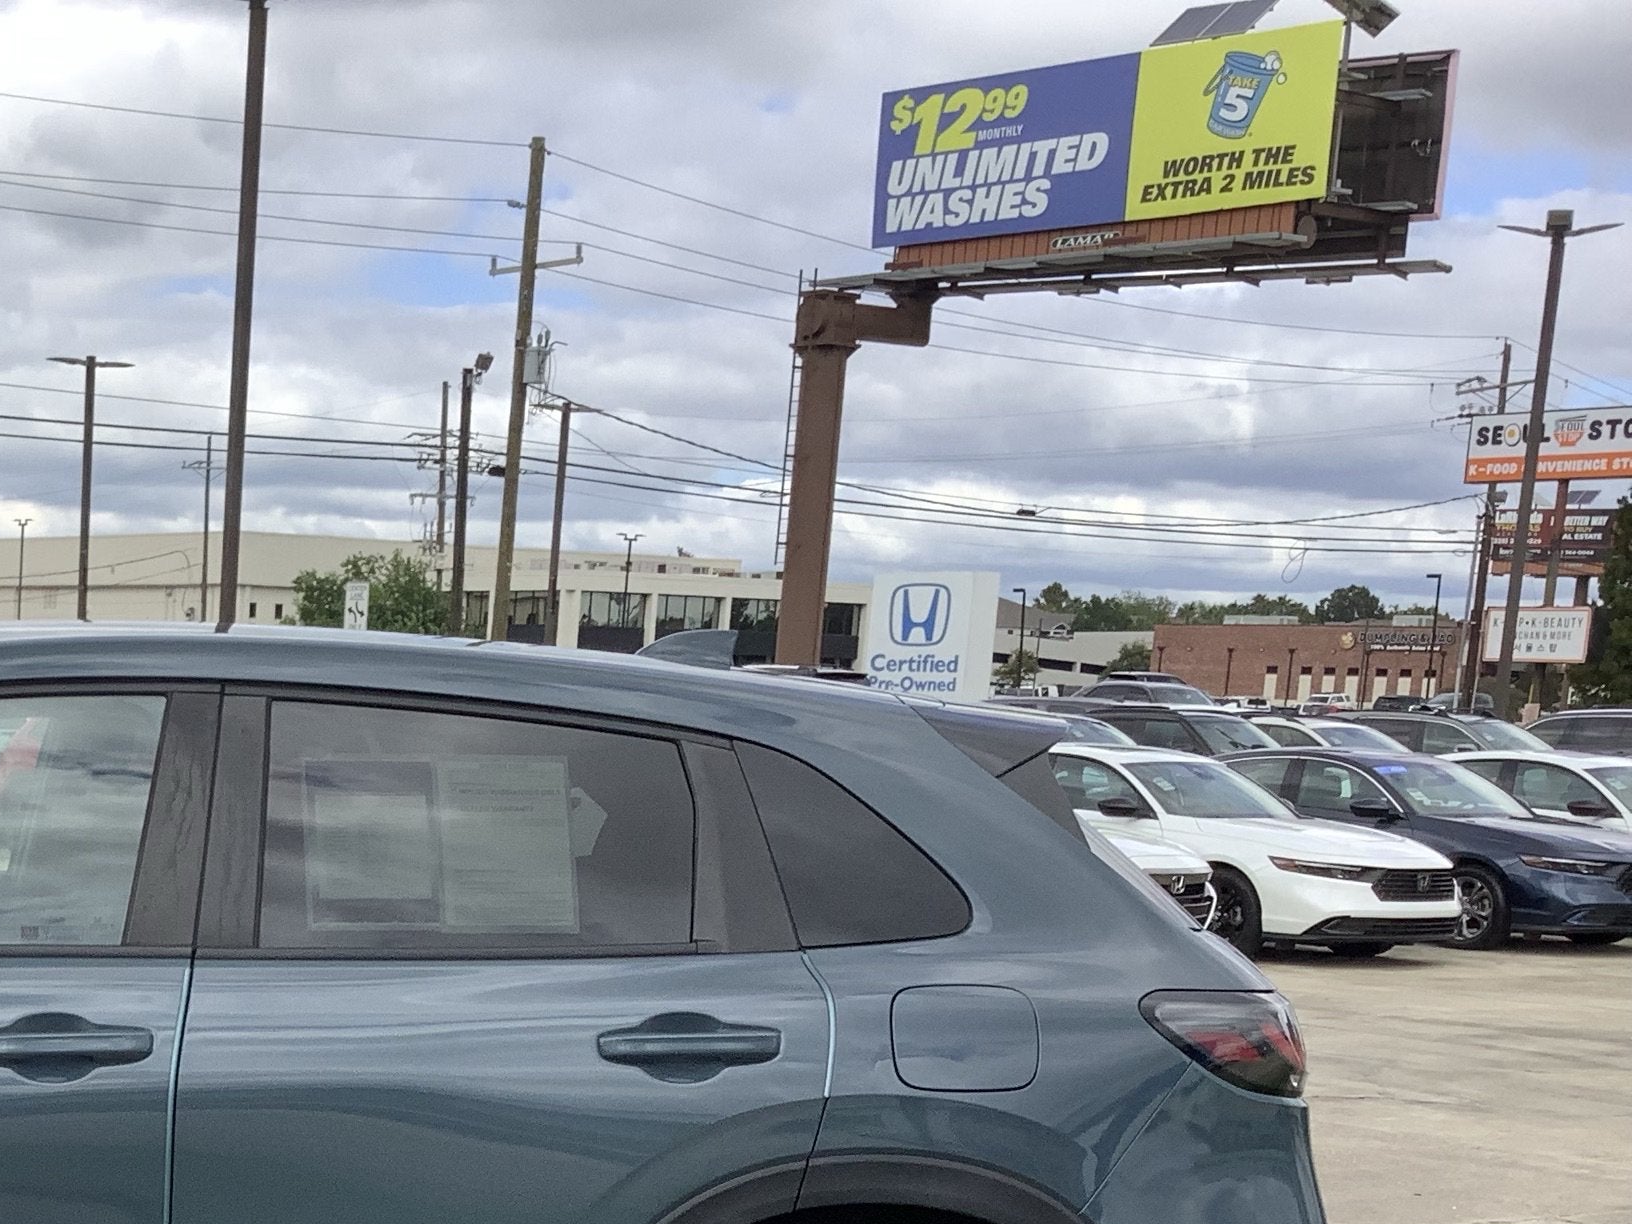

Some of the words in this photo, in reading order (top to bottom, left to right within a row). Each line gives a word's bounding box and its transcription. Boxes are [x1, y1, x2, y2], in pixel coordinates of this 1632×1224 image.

[1228, 76, 1261, 89] TAKE
[1218, 87, 1255, 122] 5
[977, 124, 1024, 141] MONTHLY
[886, 131, 1110, 197] UNLIMITED
[1162, 150, 1246, 179] WORTH
[1252, 144, 1297, 167] THE
[1140, 176, 1212, 203] EXTRA
[1219, 174, 1236, 194] 2
[1241, 165, 1317, 191] MILES
[885, 178, 1052, 233] WASHES
[1476, 422, 1551, 446] SEOL
[1468, 462, 1518, 477] K-FOOD
[1521, 458, 1608, 473] NVENIENCE
[870, 653, 959, 673] Certified
[869, 675, 957, 692] Pre-Owned
